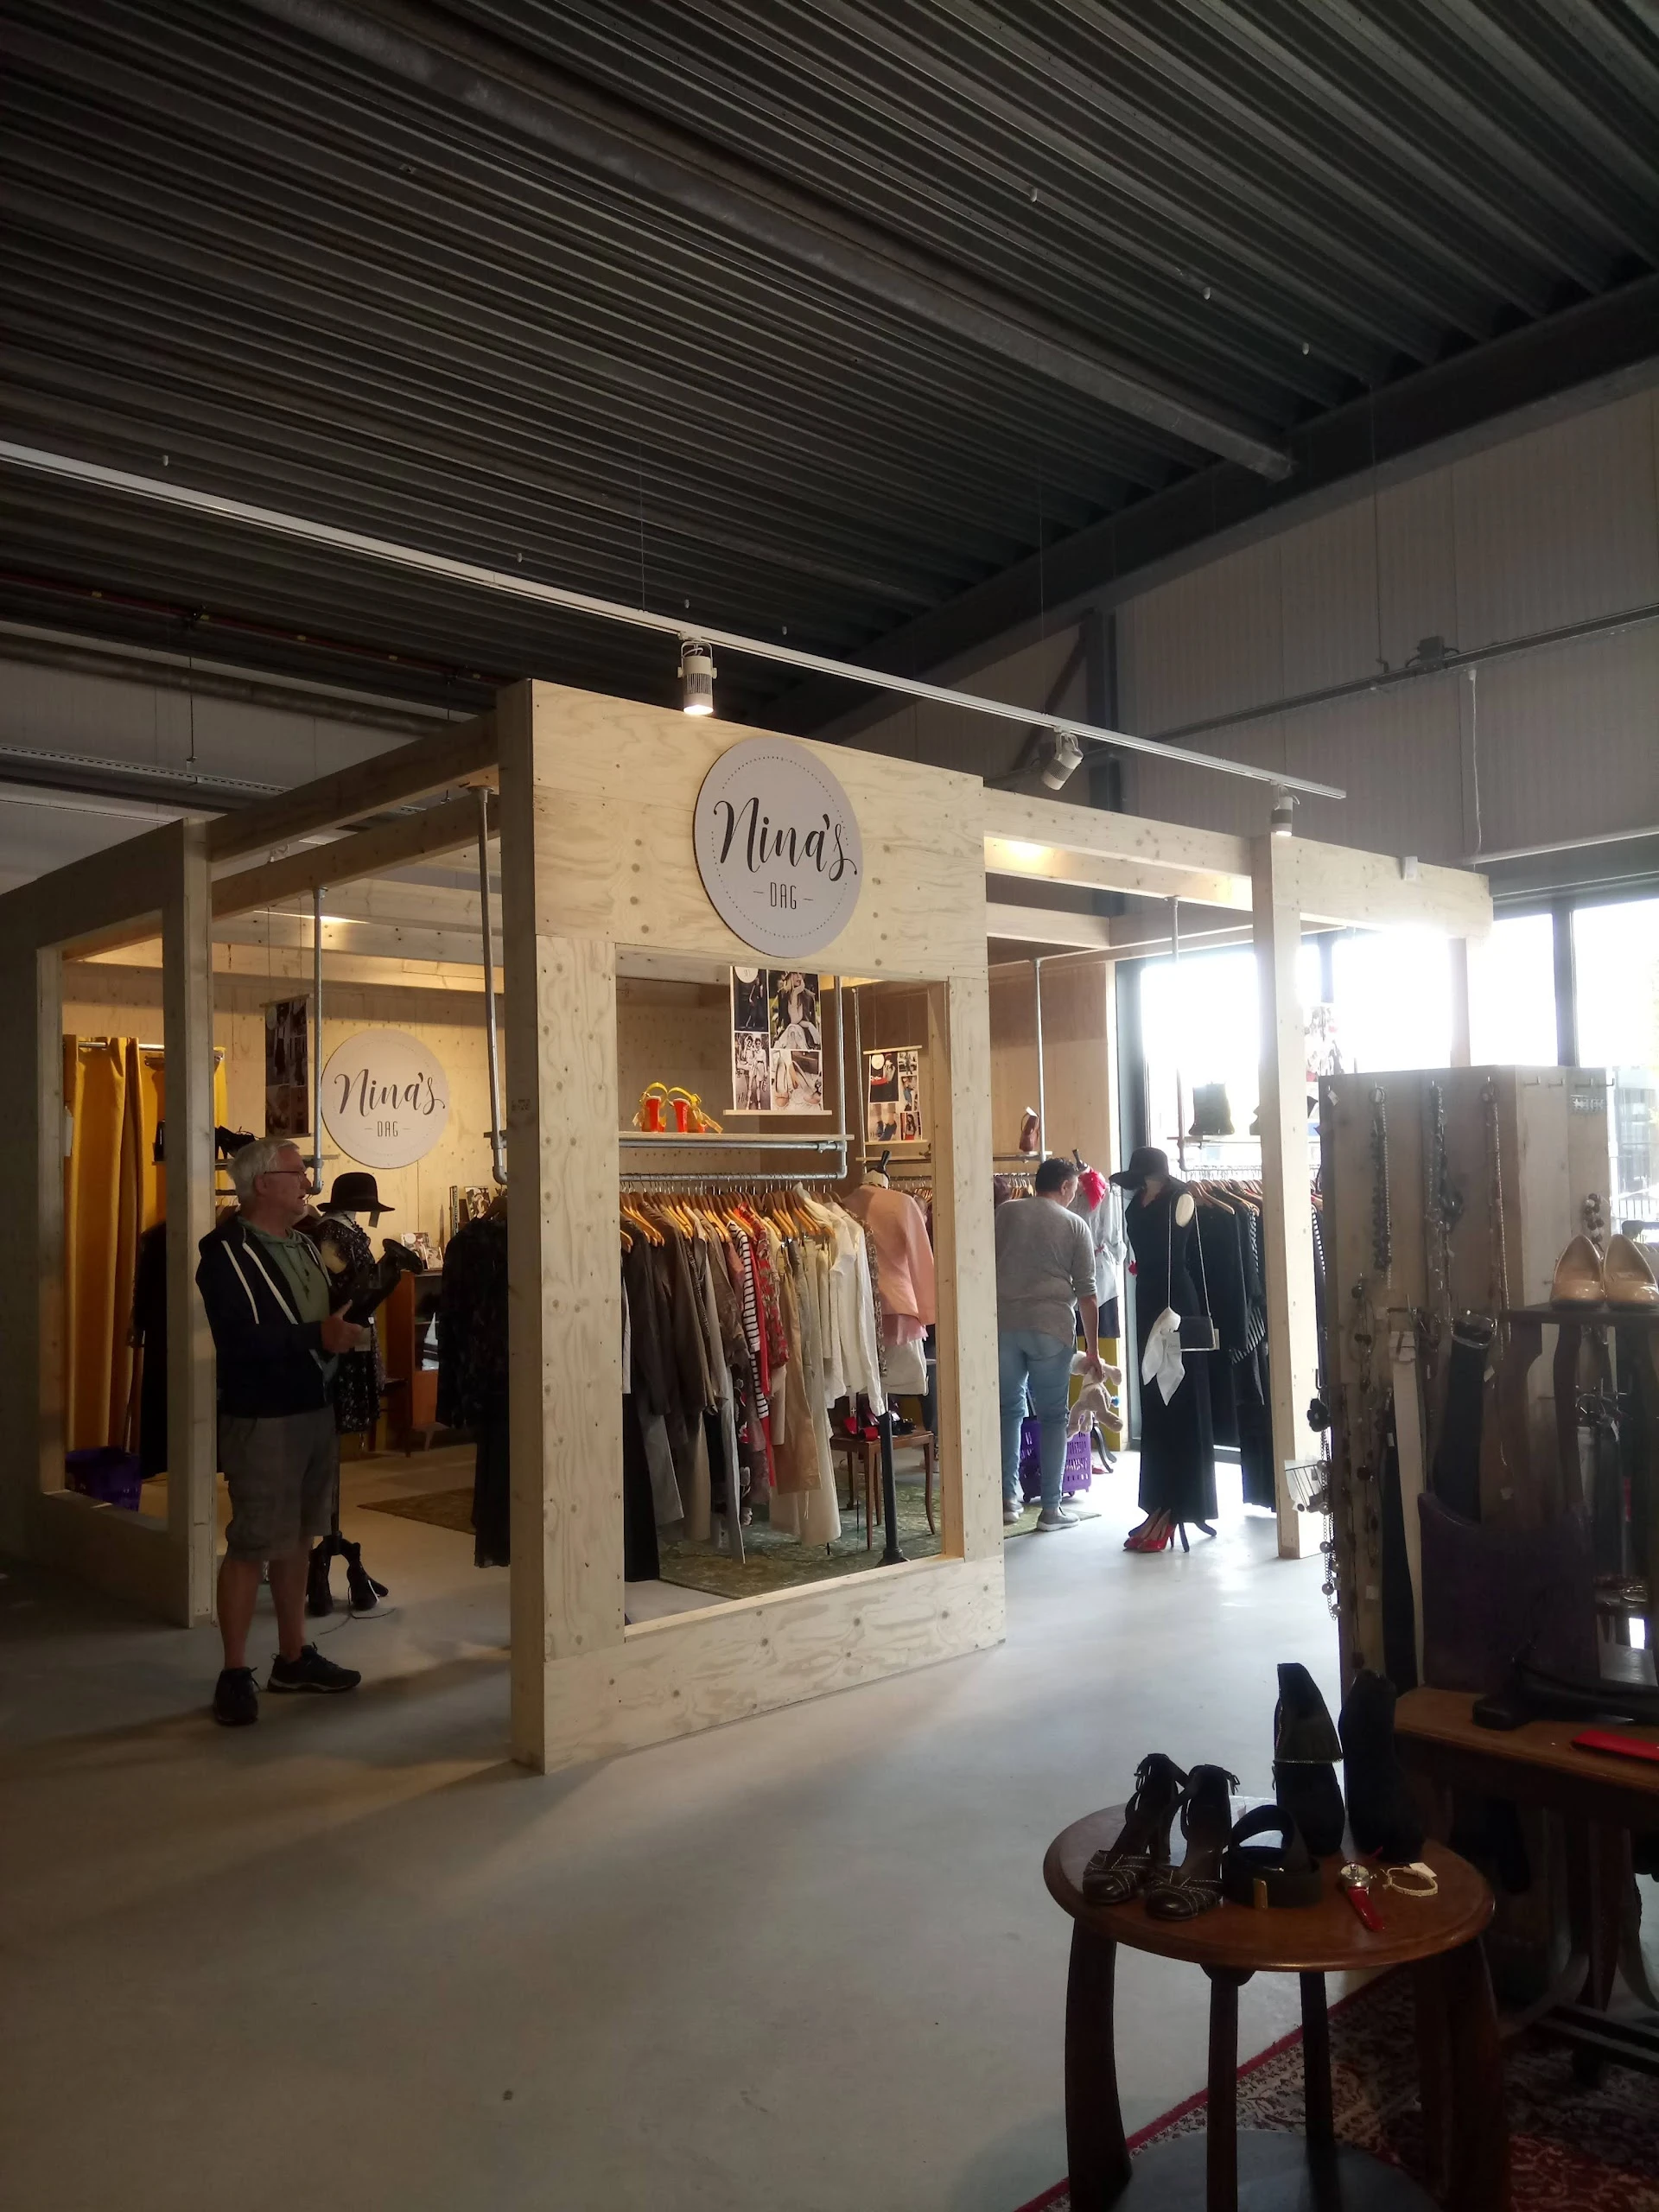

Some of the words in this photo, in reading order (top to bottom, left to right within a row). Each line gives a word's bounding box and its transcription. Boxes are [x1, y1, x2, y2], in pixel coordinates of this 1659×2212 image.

[713, 797, 858, 882] Nina's
[770, 881, 798, 910] DAG
[334, 1068, 446, 1117] Nina's
[377, 1121, 399, 1137] DAG
